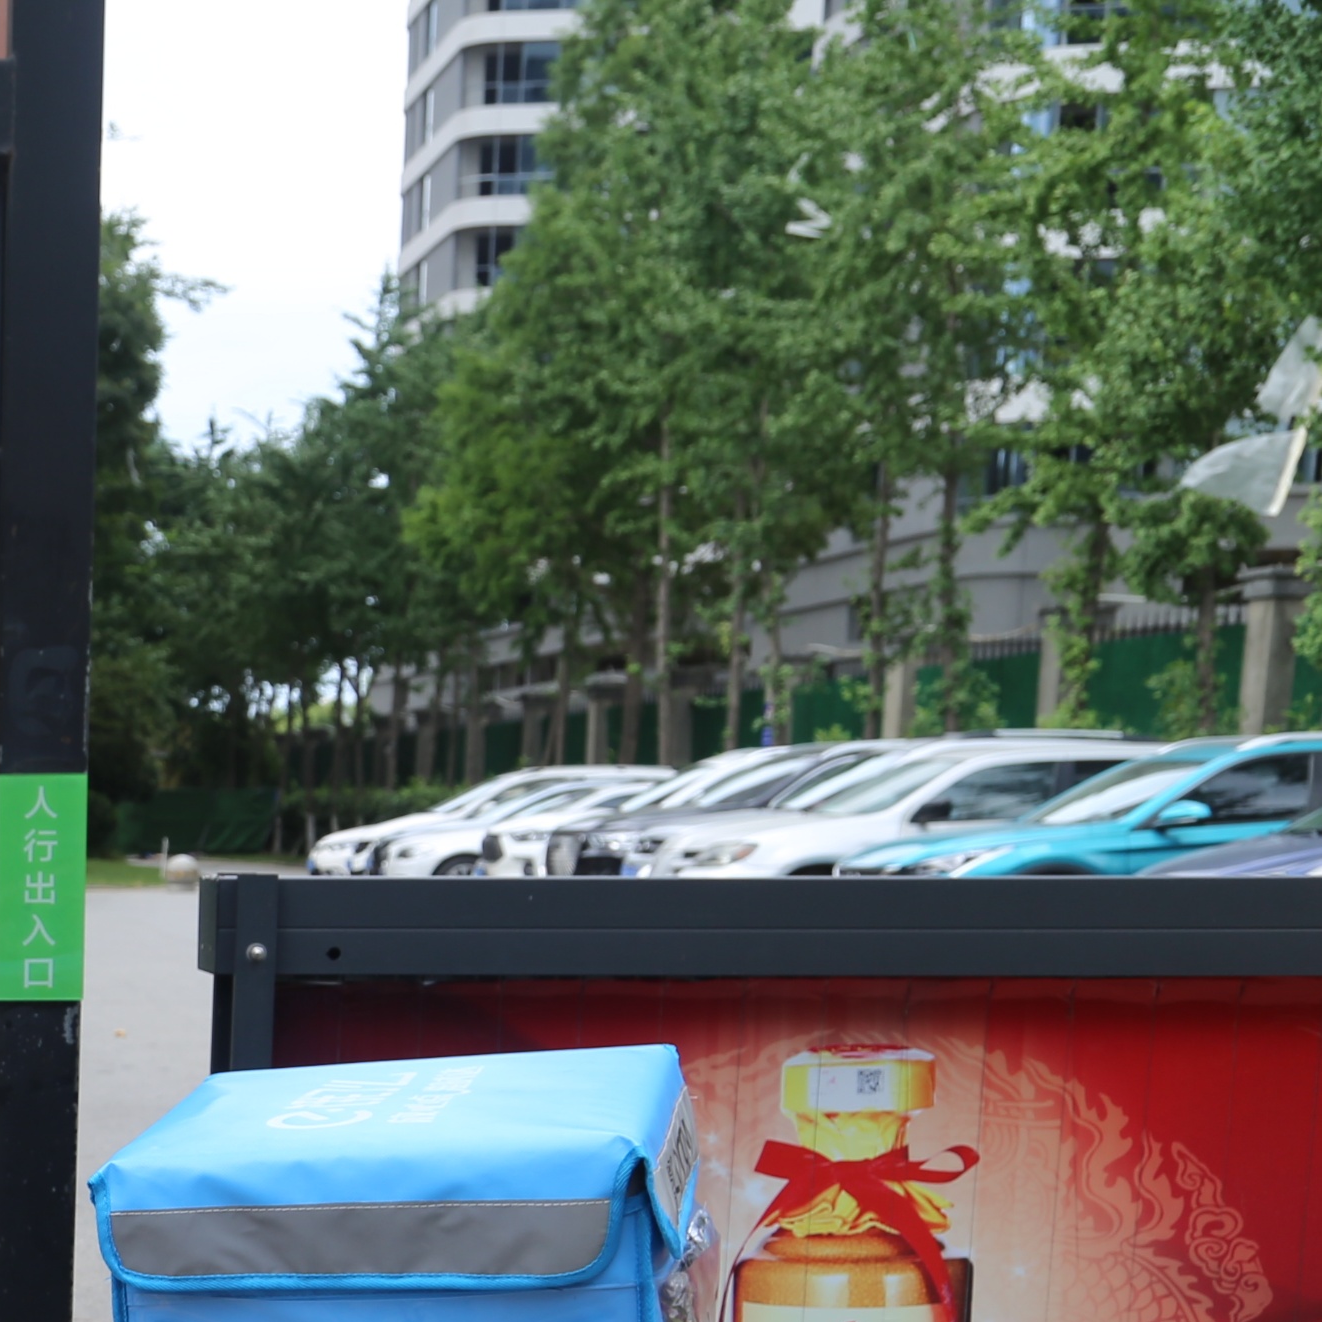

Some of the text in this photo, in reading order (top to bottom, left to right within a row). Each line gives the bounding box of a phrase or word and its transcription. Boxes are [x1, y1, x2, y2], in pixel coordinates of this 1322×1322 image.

[22, 786, 58, 989] 人行出入口
